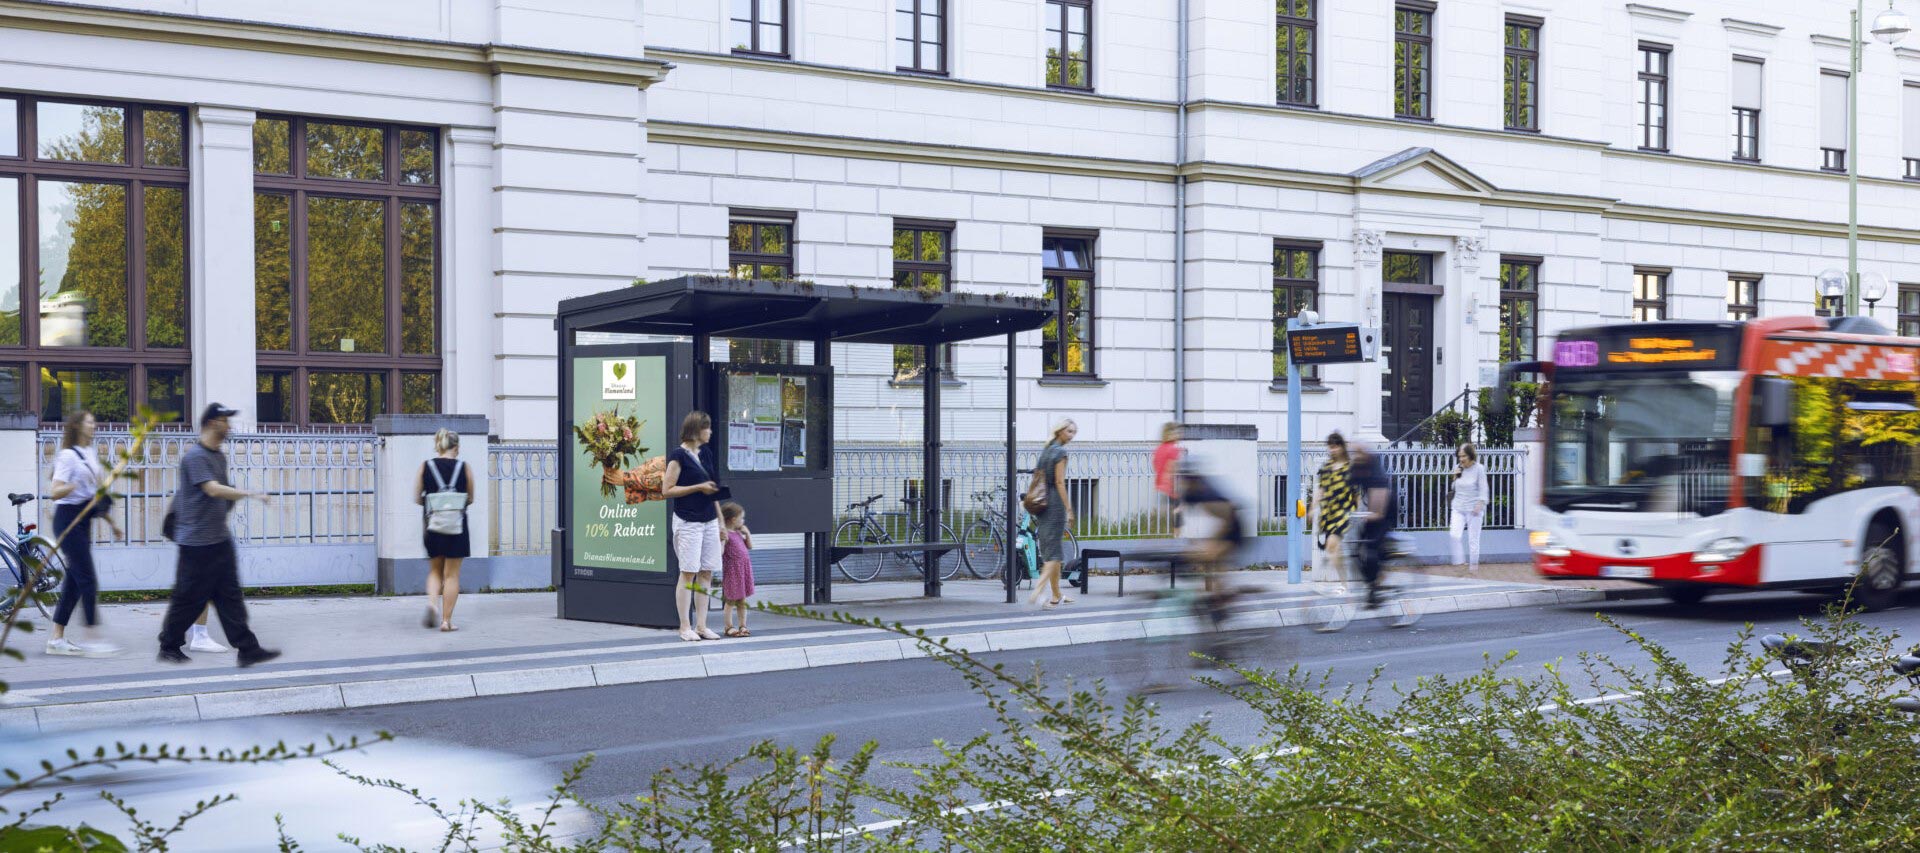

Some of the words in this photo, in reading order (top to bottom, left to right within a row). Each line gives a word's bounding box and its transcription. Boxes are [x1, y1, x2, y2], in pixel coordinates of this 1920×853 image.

[599, 503, 638, 519] Online
[585, 523, 609, 538] 10%
[613, 522, 655, 537] Rabatt
[583, 551, 655, 565] DianasBlumenland.de
